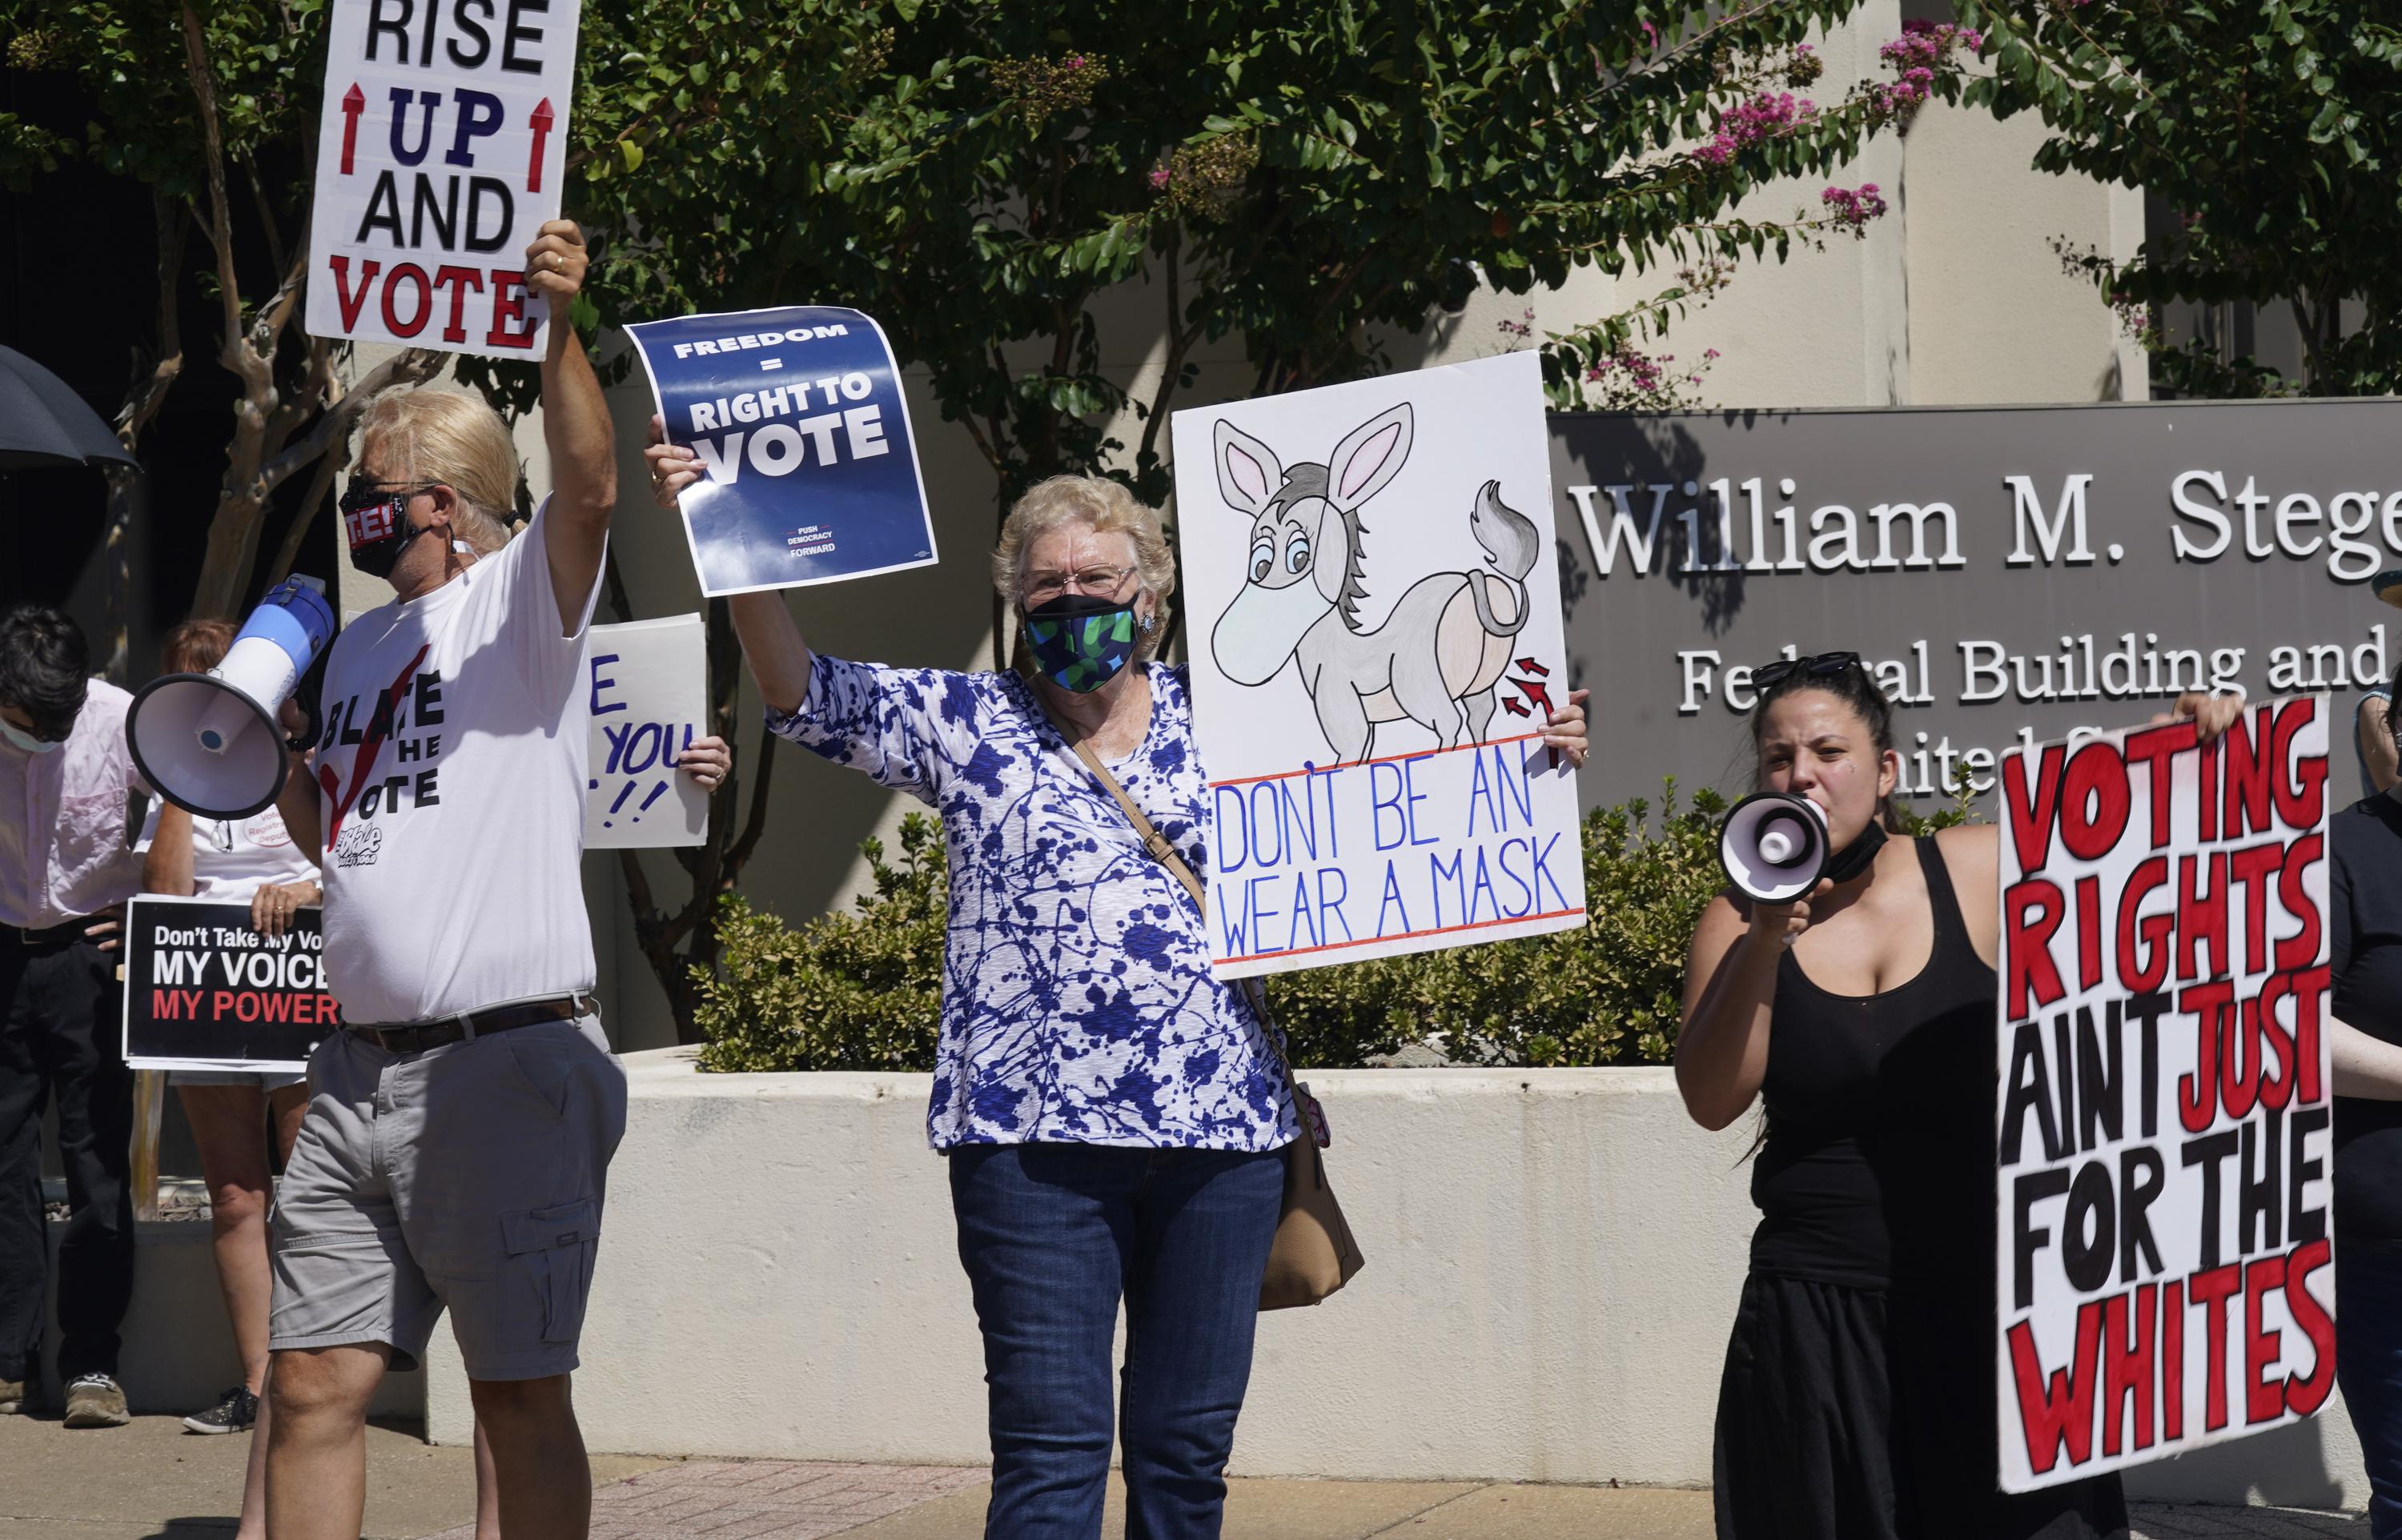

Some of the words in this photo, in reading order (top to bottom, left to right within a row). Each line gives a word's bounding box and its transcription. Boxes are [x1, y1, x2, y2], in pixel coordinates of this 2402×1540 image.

[365, 0, 550, 75] RISE
[389, 87, 504, 167] UP
[355, 170, 515, 254] AND
[329, 255, 540, 350] VOTE
[673, 324, 849, 359] FREEDOM
[689, 383, 811, 433] RIGHT
[817, 371, 873, 406] TO
[690, 403, 890, 487] VOTE
[787, 531, 833, 545] DEMOCRACY
[789, 543, 836, 558] FORWARD
[797, 525, 818, 535] PUSH
[1567, 477, 1967, 575] William
[2003, 474, 2124, 564] M.
[1677, 640, 1935, 712] Feal
[1958, 632, 2247, 704] Building
[2267, 624, 2389, 690] and
[602, 722, 693, 776] YOU
[2002, 697, 2329, 878] VOTING
[1215, 760, 1344, 873] DON'T
[1370, 754, 1440, 851] BE
[1468, 740, 1533, 838] AN
[1217, 867, 1352, 957] WEAR
[1376, 860, 1411, 938] A
[1430, 832, 1569, 929] MASK
[2004, 831, 2324, 1023] RIGHTS
[153, 950, 212, 985] MY
[154, 926, 208, 947] Don't
[213, 927, 259, 948] Take
[152, 989, 205, 1021] MY
[213, 990, 339, 1025] POWER
[2000, 993, 2172, 1166] AINT
[2178, 963, 2332, 1133] JUST
[2013, 1146, 2166, 1311] FOR
[2181, 1105, 2331, 1269] THE
[2006, 1237, 2337, 1476] WHITES
